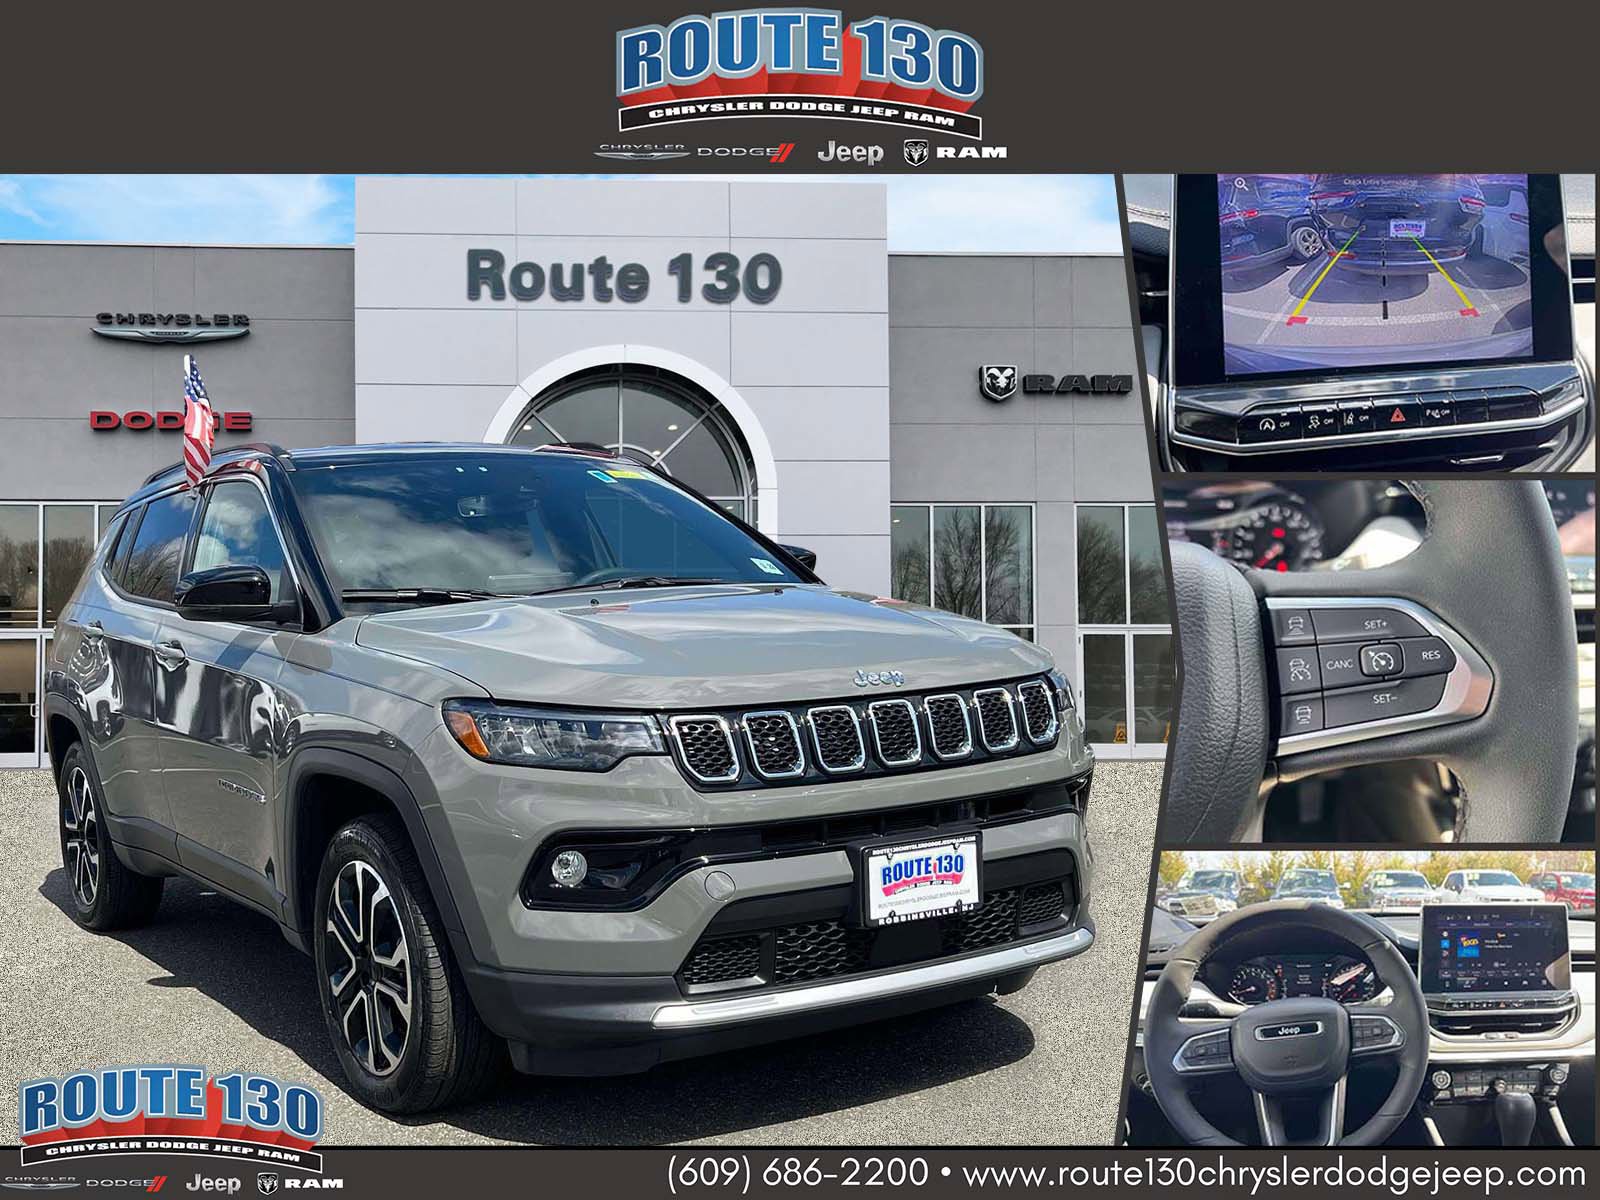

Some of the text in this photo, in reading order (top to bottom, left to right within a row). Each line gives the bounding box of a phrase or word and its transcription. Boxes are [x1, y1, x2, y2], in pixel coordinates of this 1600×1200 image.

[466, 248, 783, 305] Route 130
[96, 312, 250, 326] CHRYSLER
[1022, 373, 1134, 395] RAM
[89, 411, 253, 432] DODE
[1364, 619, 1388, 630] SET+
[1422, 650, 1441, 661] RES
[1326, 659, 1354, 671] CANC
[853, 668, 905, 687] Jeep
[881, 854, 965, 886] ROUTE 130
[961, 903, 974, 912] NJ
[1278, 1024, 1300, 1035] Jeep
